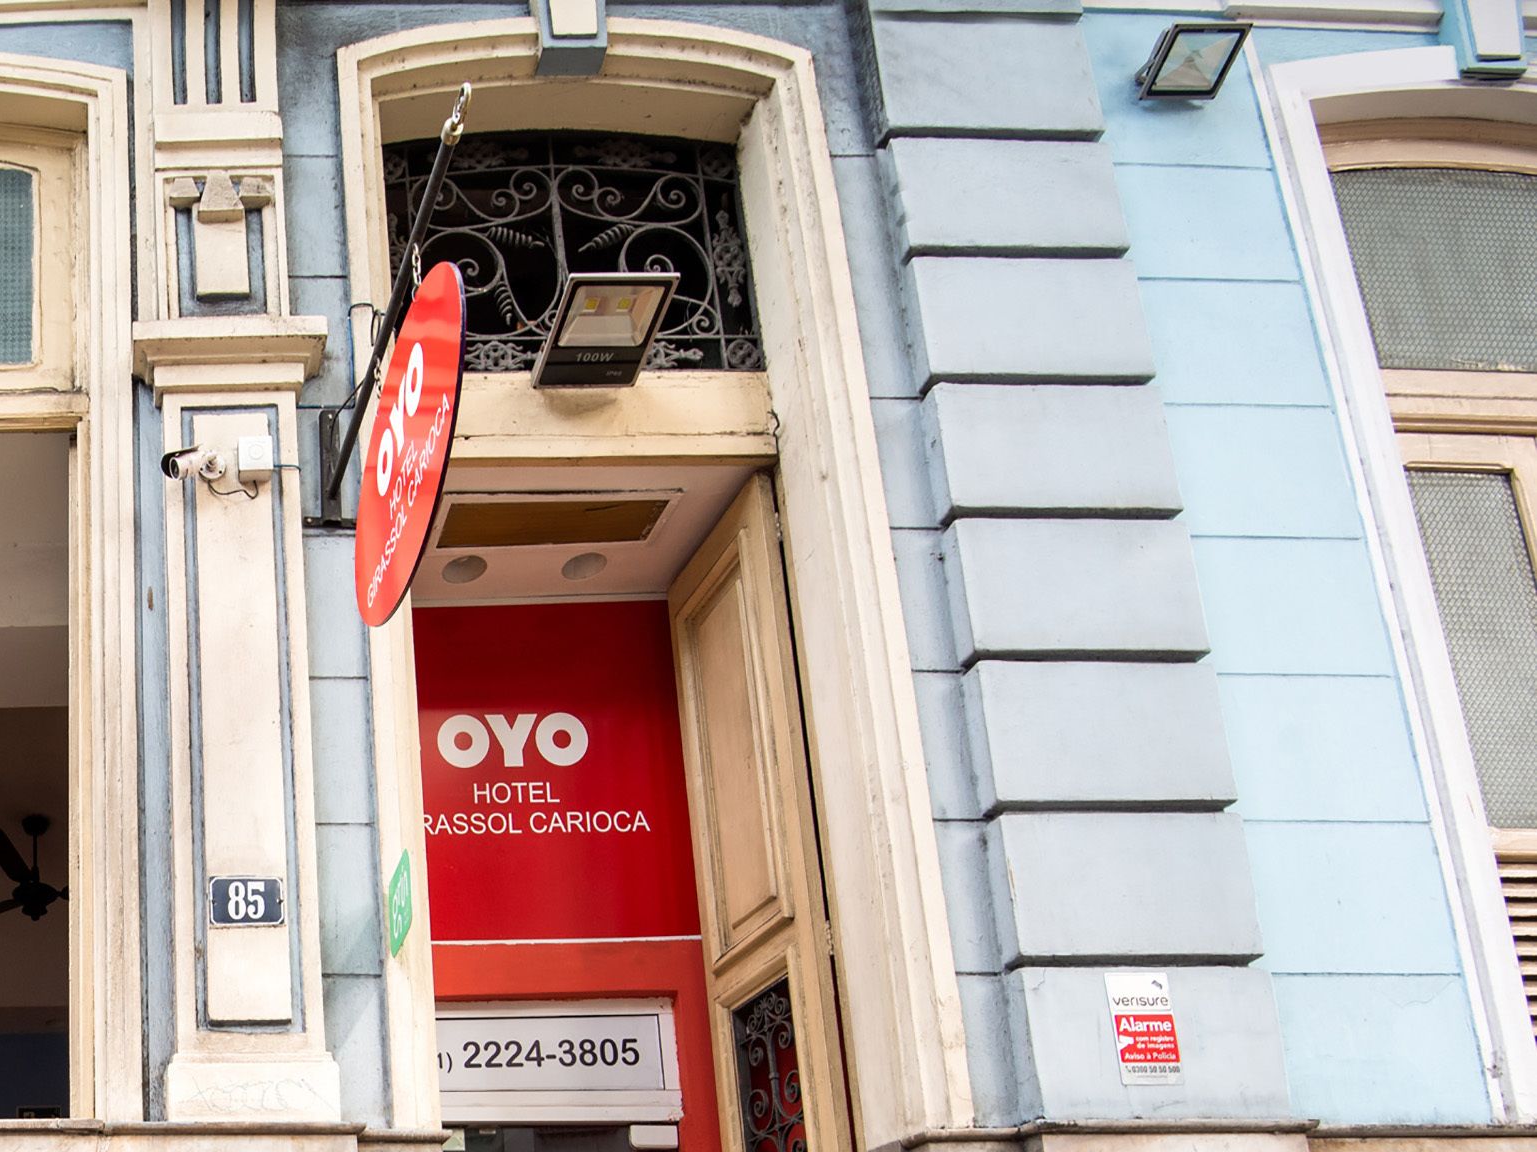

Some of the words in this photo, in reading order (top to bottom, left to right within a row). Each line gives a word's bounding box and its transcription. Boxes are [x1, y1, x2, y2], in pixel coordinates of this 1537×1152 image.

[574, 351, 615, 363] 100W
[376, 341, 424, 497] OYO
[388, 439, 419, 519] HOTEL
[366, 508, 409, 608] GIRASSOL
[407, 394, 450, 507] CARIOCA
[437, 712, 589, 769] OYO
[473, 782, 561, 804] HOTEL
[424, 812, 522, 835] RASSOL
[529, 810, 651, 834] CARIOCA
[227, 881, 266, 920] 85
[1112, 996, 1169, 1007] verisure
[1119, 1016, 1172, 1032] Alarme
[436, 1052, 453, 1073] 1)
[462, 1038, 640, 1069] 2224-3805
